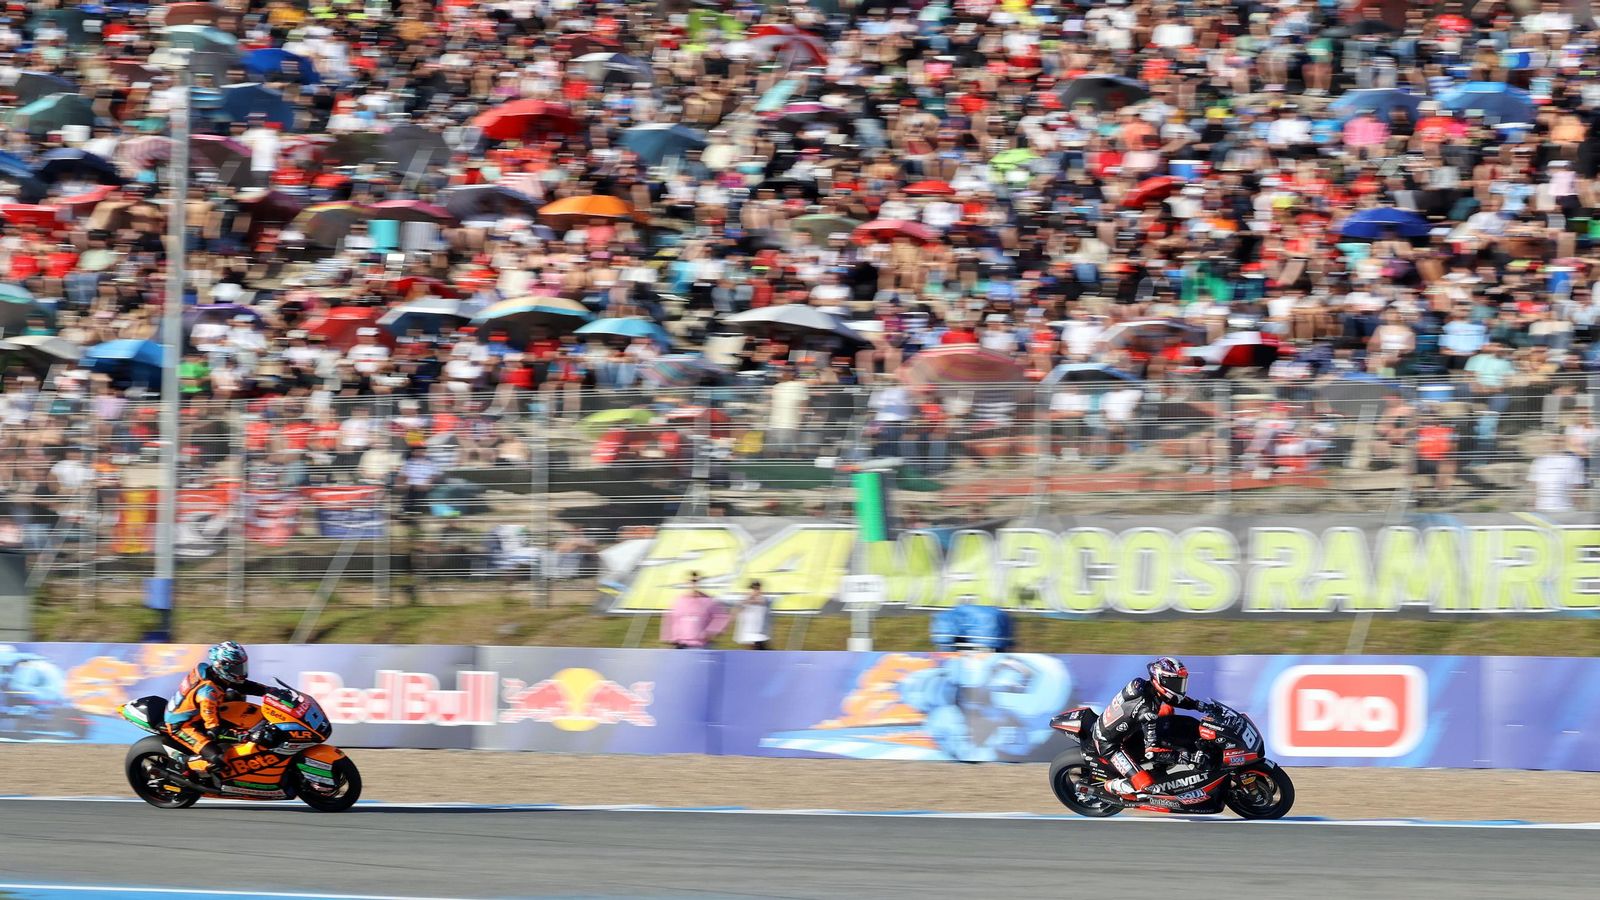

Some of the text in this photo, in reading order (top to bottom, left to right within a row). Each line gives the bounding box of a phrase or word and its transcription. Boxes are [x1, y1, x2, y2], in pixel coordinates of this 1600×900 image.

[607, 523, 858, 613] 24
[866, 527, 1242, 614] MARCOS
[231, 754, 280, 774] Beta
[1152, 772, 1209, 793] DYNAVOLT
